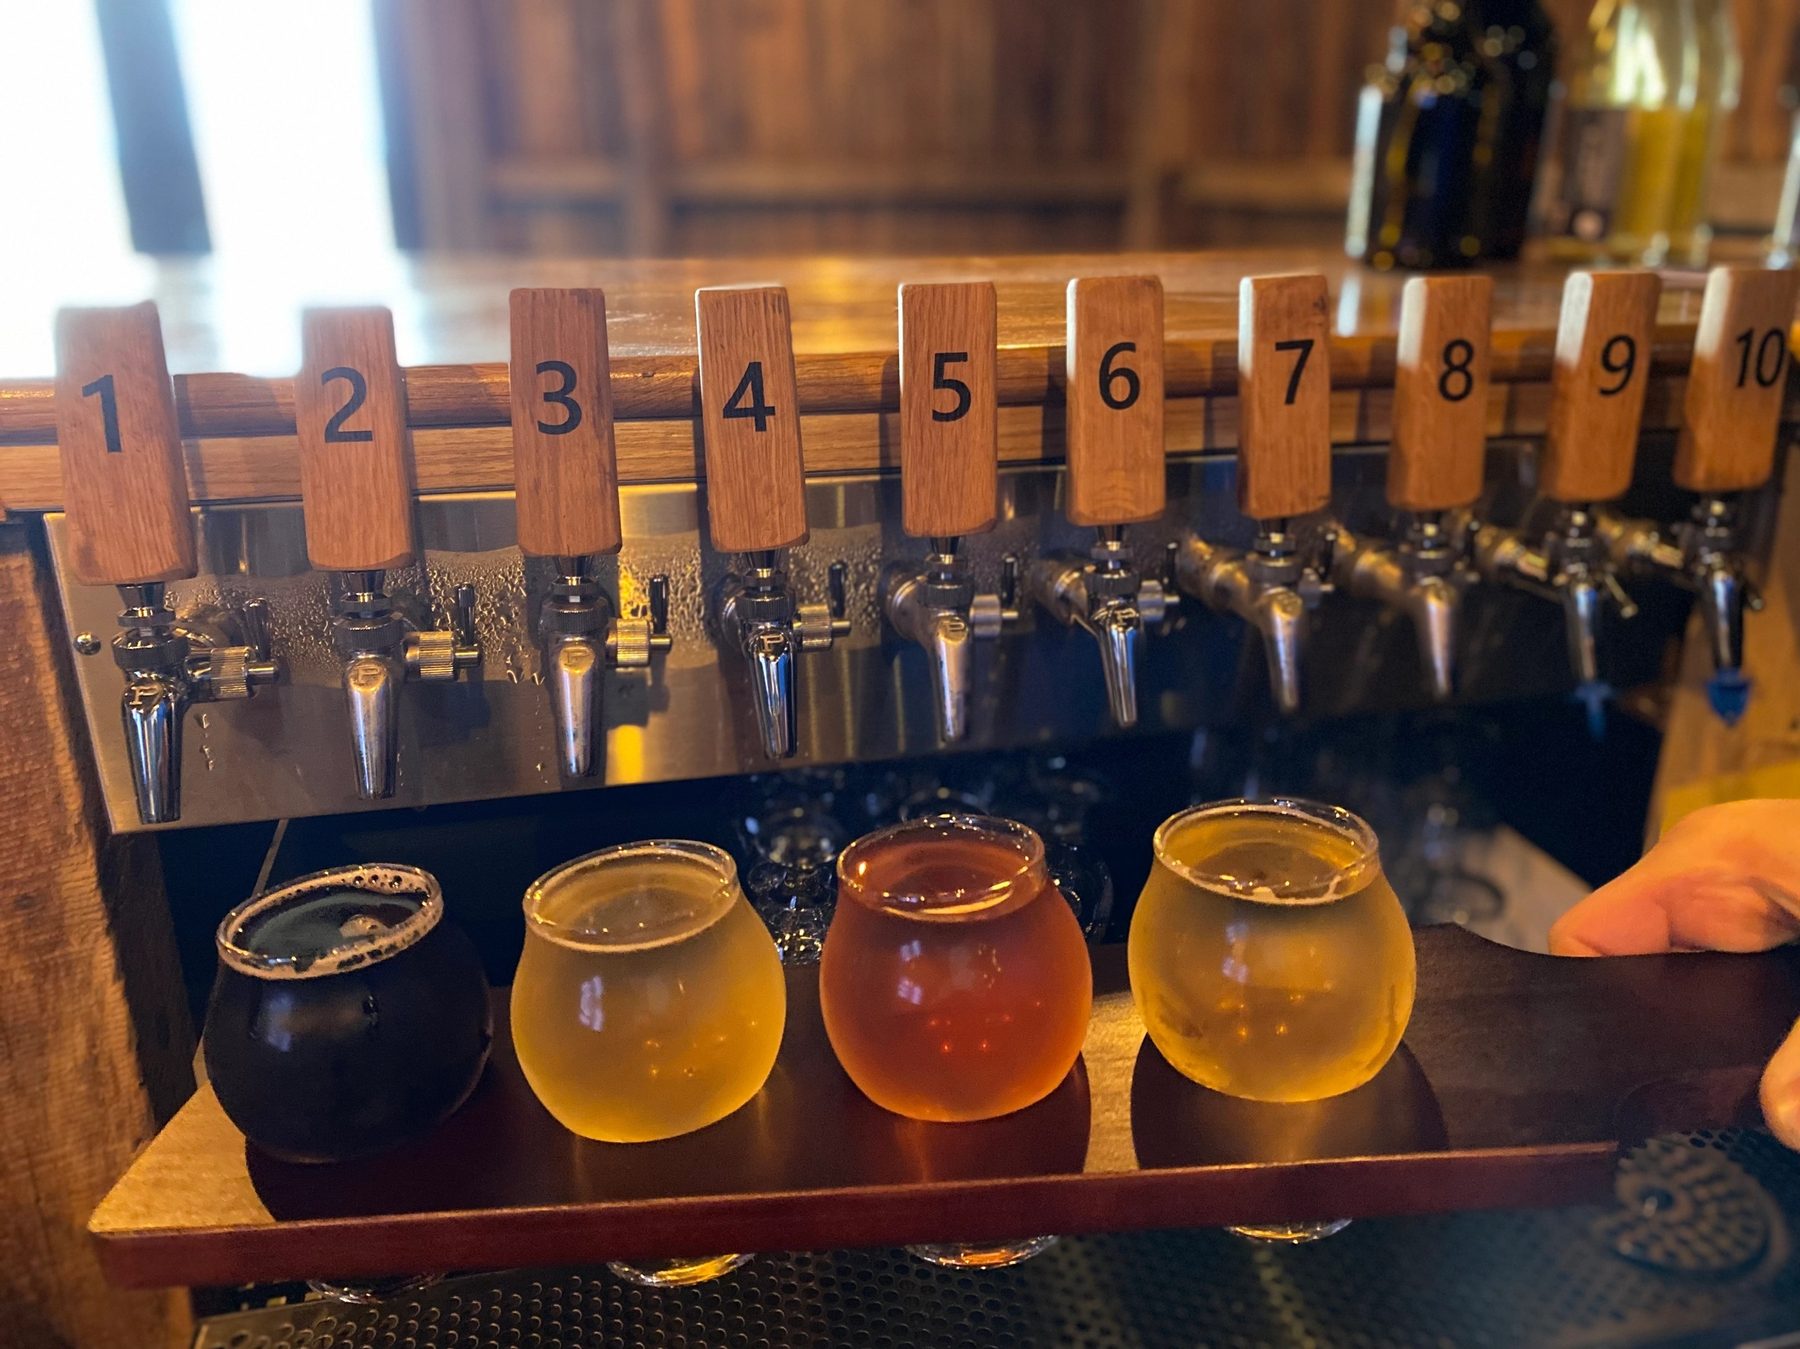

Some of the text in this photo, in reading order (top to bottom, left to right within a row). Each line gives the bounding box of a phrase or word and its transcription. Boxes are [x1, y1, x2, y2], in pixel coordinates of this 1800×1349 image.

[931, 351, 972, 423] 5
[1098, 341, 1141, 411] 6
[1274, 338, 1315, 406] 7
[1436, 336, 1477, 404] 8
[1598, 333, 1639, 399] 9
[1736, 326, 1785, 389] 10
[82, 374, 122, 453] 1
[321, 367, 373, 443] 2
[535, 360, 583, 435] 3
[722, 361, 776, 433] 4
[354, 664, 381, 686] P
[760, 633, 784, 653] P
[129, 685, 163, 705] P
